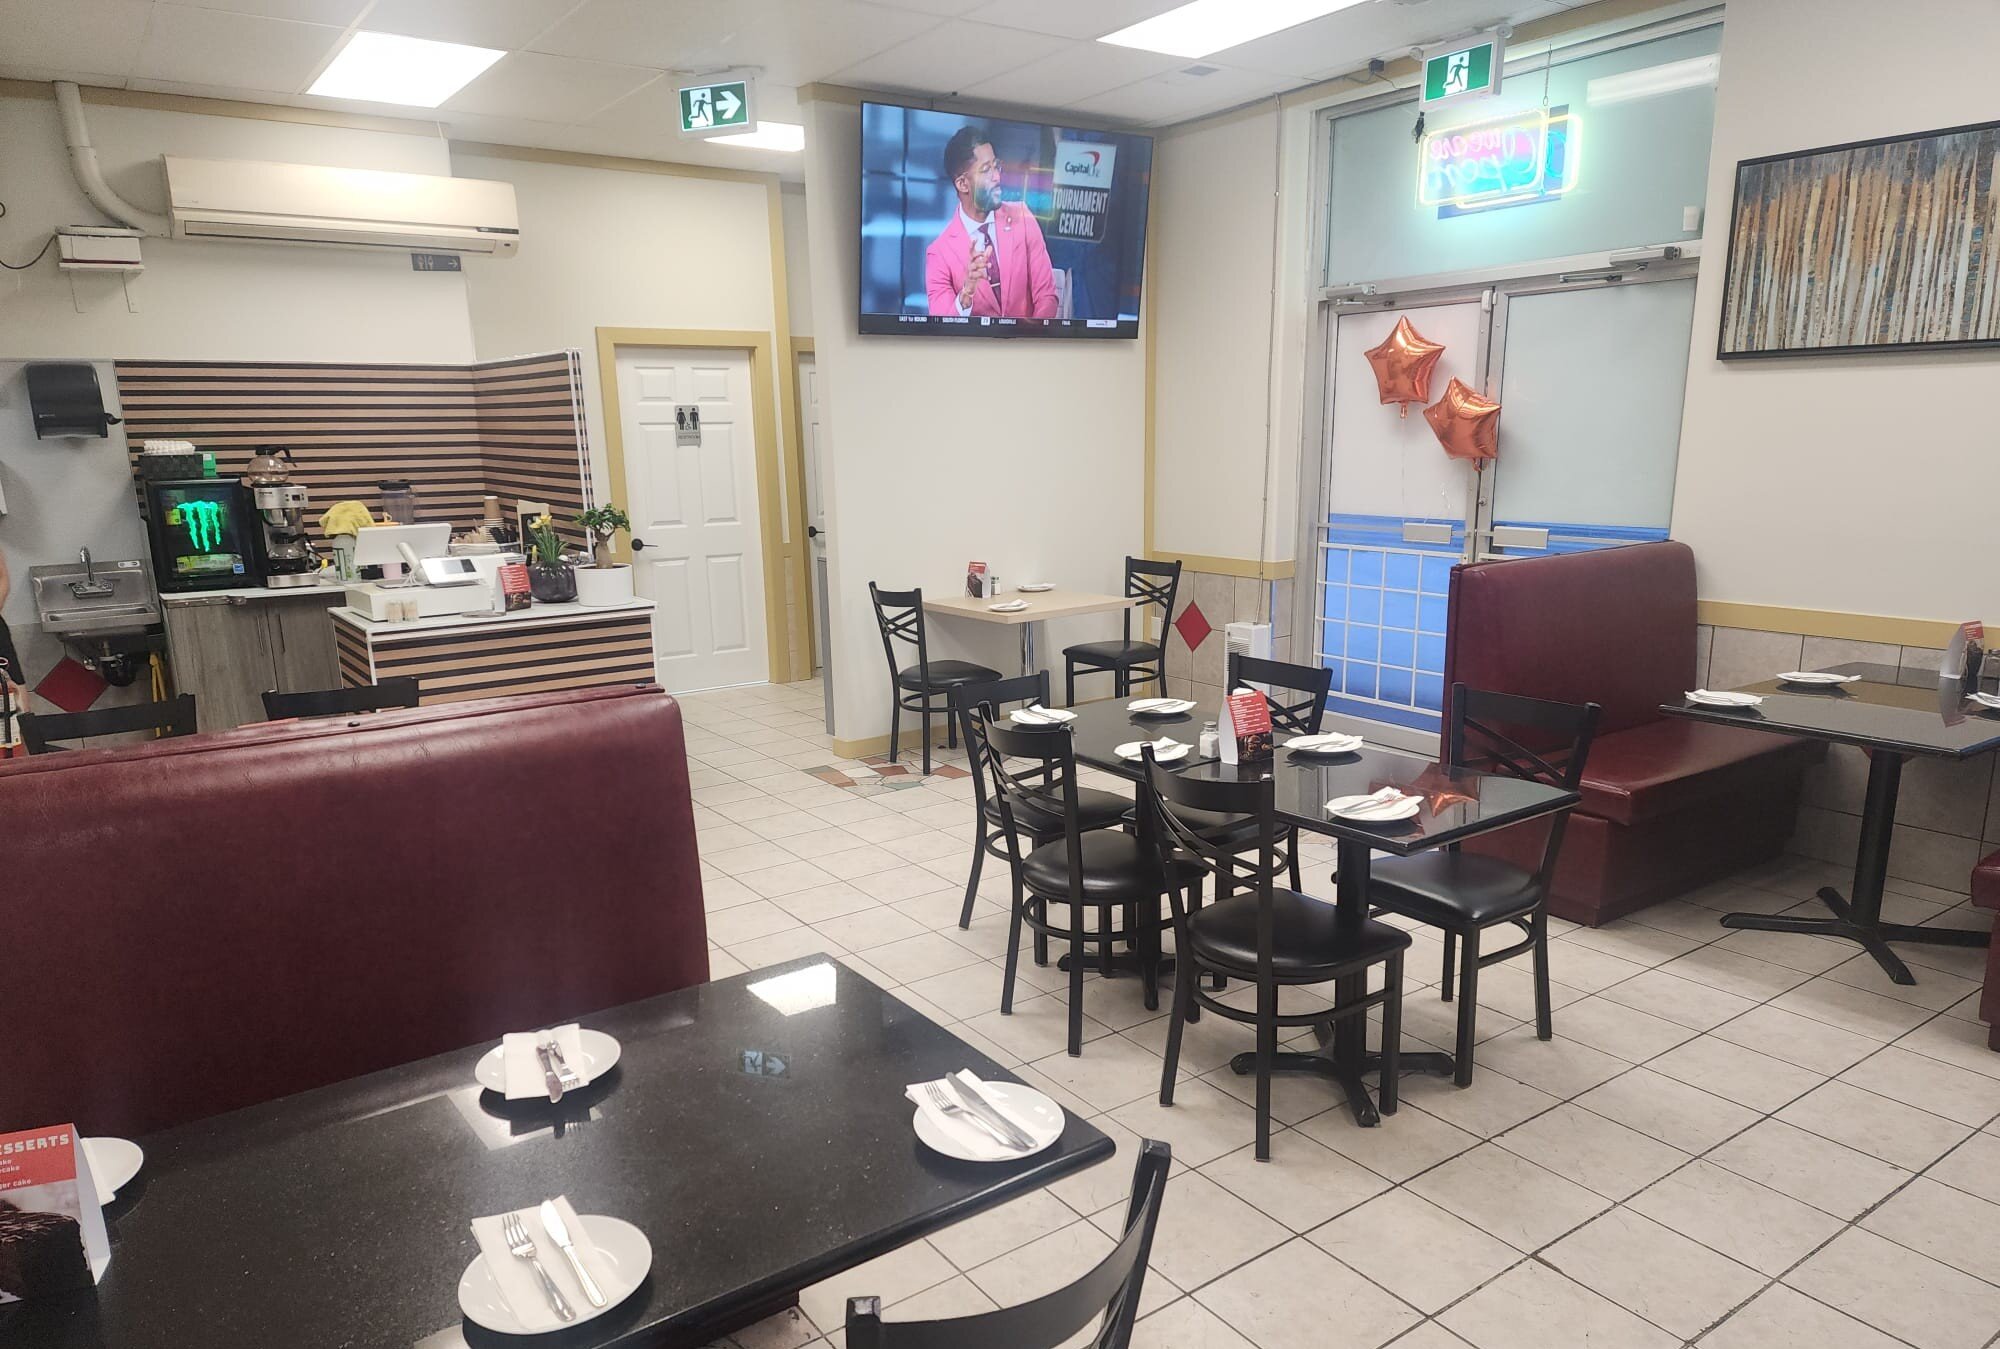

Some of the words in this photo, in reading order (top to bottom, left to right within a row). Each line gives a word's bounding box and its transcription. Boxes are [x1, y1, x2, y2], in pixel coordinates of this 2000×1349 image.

[1064, 161, 1090, 176] Capital
[1053, 188, 1109, 214] TOURNAMENT
[1058, 213, 1095, 237] CENTRAL
[0, 1134, 69, 1155] SSERTS
[13, 1179, 32, 1187] cake
